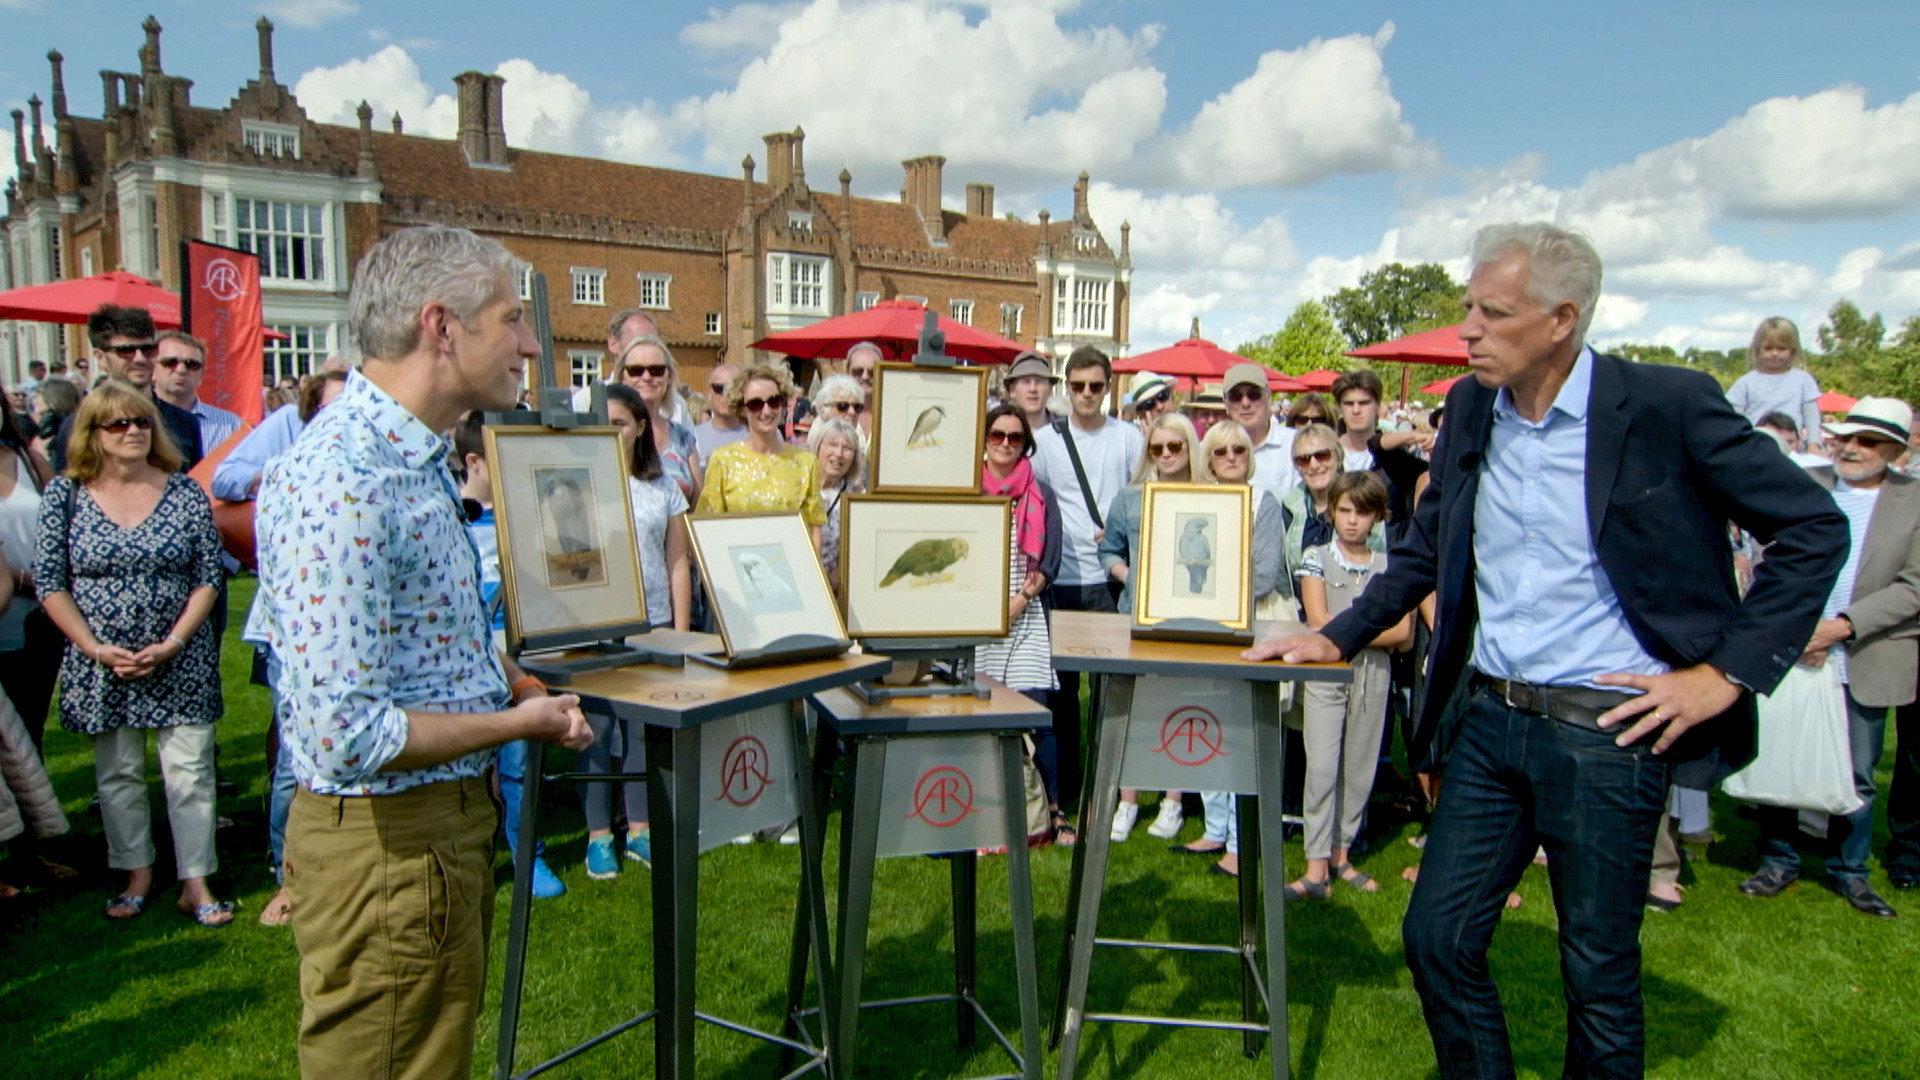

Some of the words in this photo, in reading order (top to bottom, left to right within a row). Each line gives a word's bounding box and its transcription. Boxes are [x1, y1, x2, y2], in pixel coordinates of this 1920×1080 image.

[203, 266, 247, 293] AR
[1151, 717, 1231, 755] AR
[714, 747, 775, 801] AR
[904, 777, 981, 816] AR
